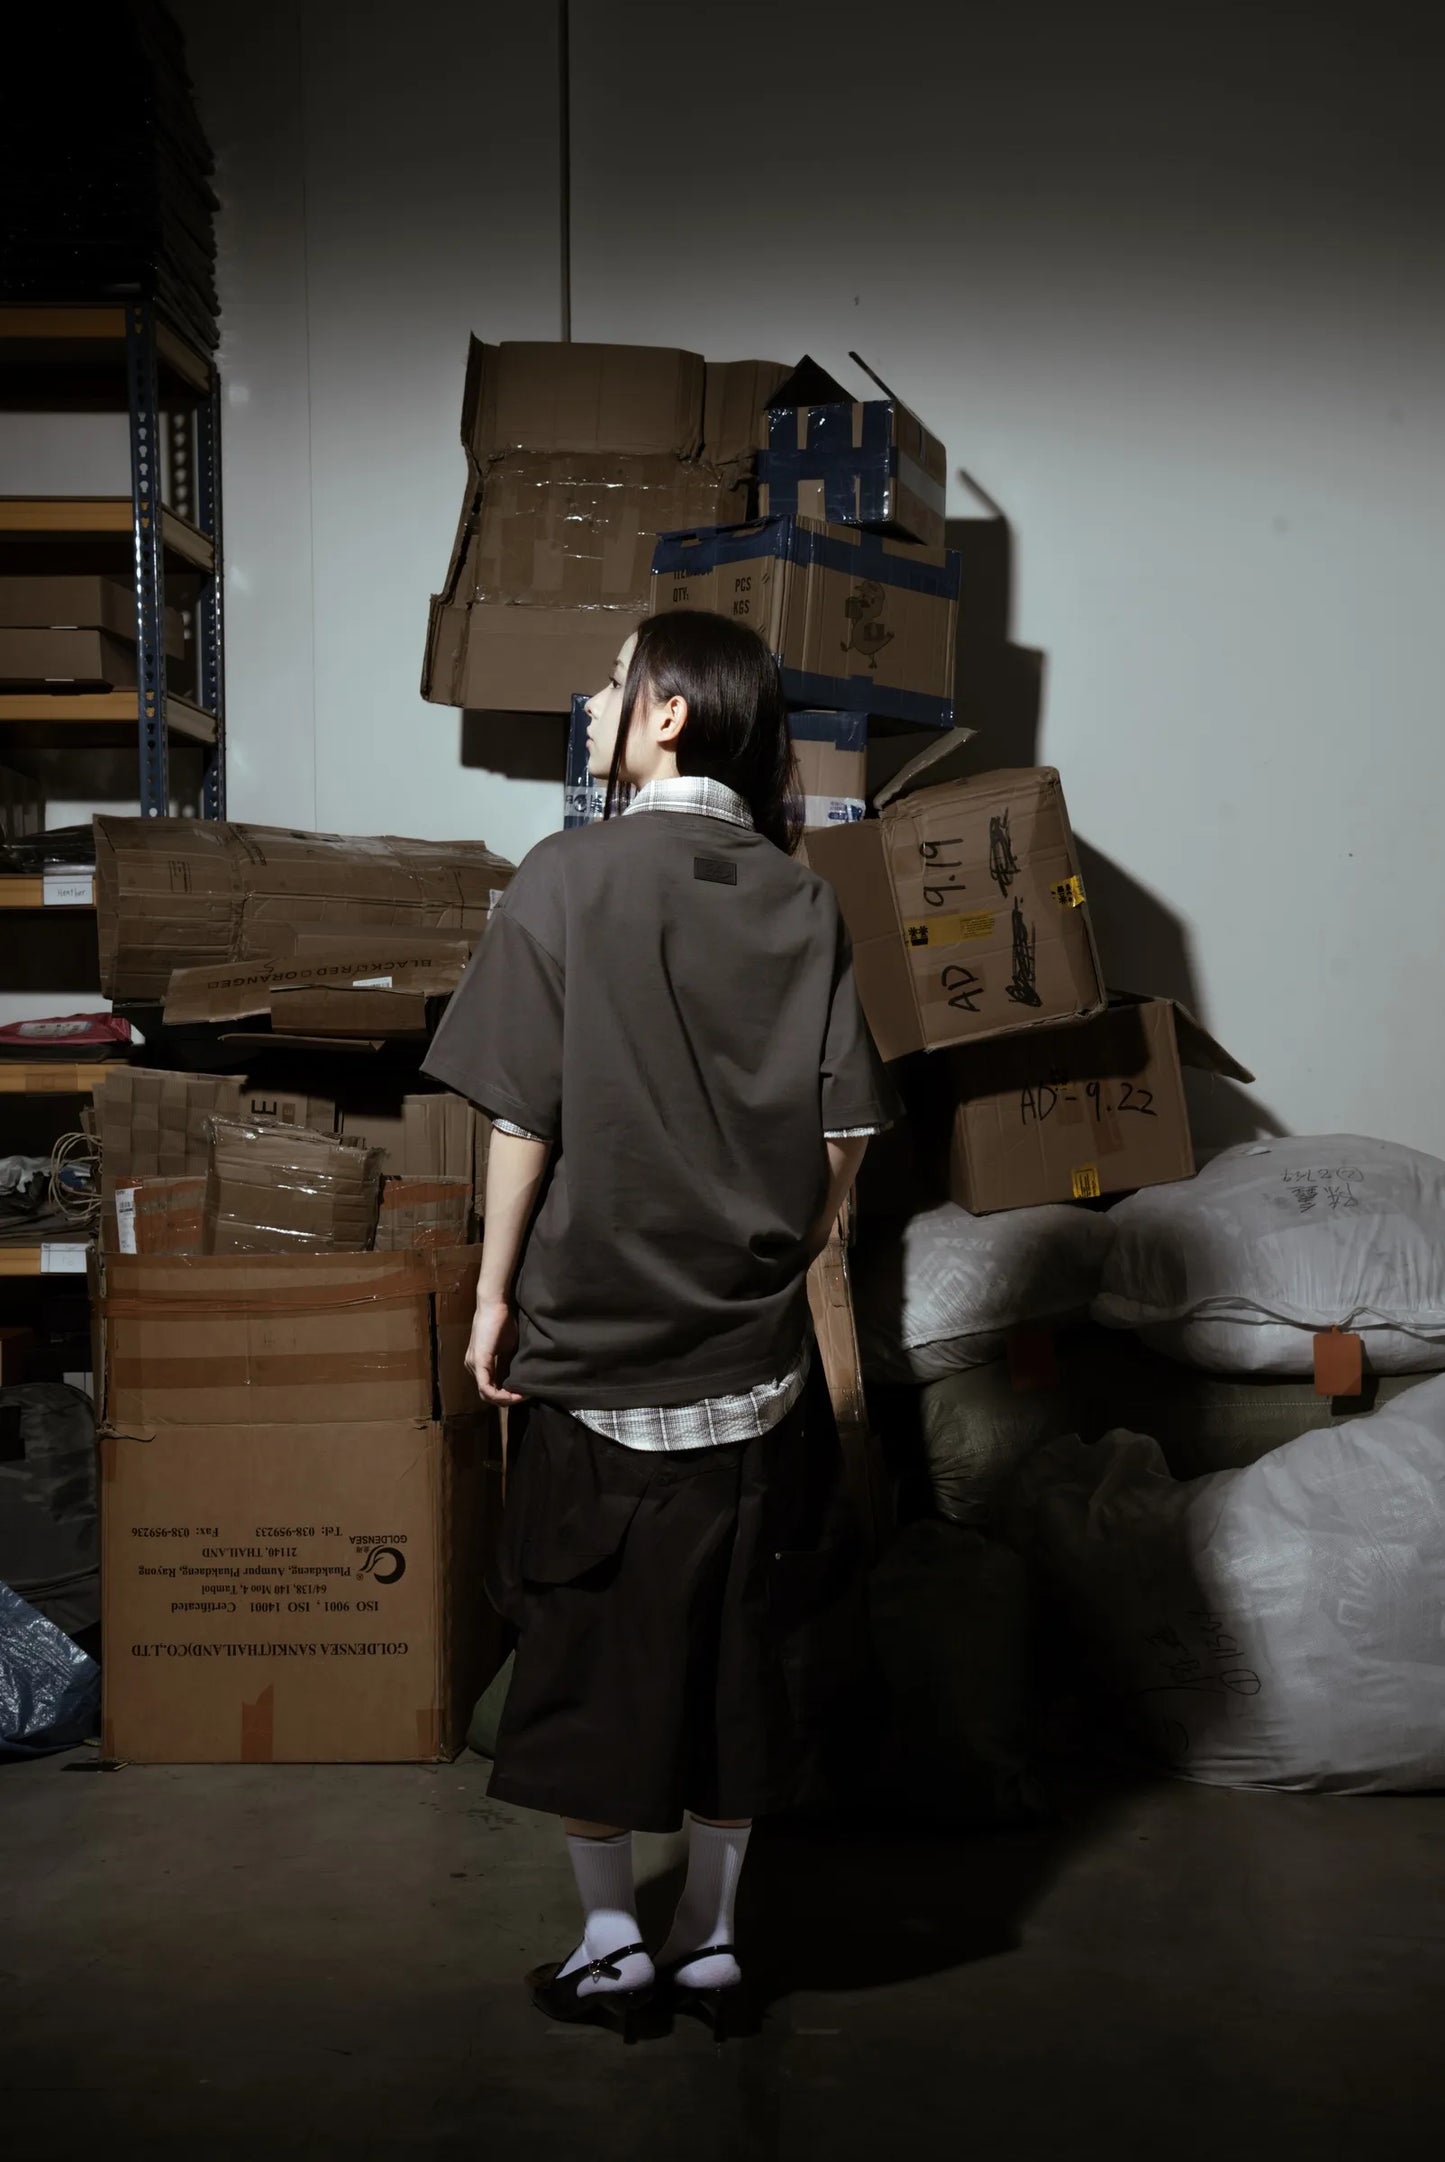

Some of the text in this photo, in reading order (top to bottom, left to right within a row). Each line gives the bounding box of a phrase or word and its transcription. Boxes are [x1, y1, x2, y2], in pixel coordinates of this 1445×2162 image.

[735, 576, 752, 593] PCS
[733, 599, 750, 616] KGS
[217, 959, 432, 988] BLACK RED ORANGE
[131, 1526, 343, 1538] Tel: 038-959233 Fax: 038-959236
[349, 1534, 408, 1545] GOLDENSEA
[202, 1547, 263, 1558] THAILAND
[138, 1565, 176, 1578] Rayong
[242, 1565, 285, 1577] Aumpur
[201, 1584, 238, 1595] Tambol
[171, 1602, 237, 1613] Certificated
[250, 1602, 281, 1613] 14001
[288, 1601, 310, 1613] ISO
[356, 1601, 379, 1612] ISO
[320, 1642, 409, 1656] GOLDENSEA
